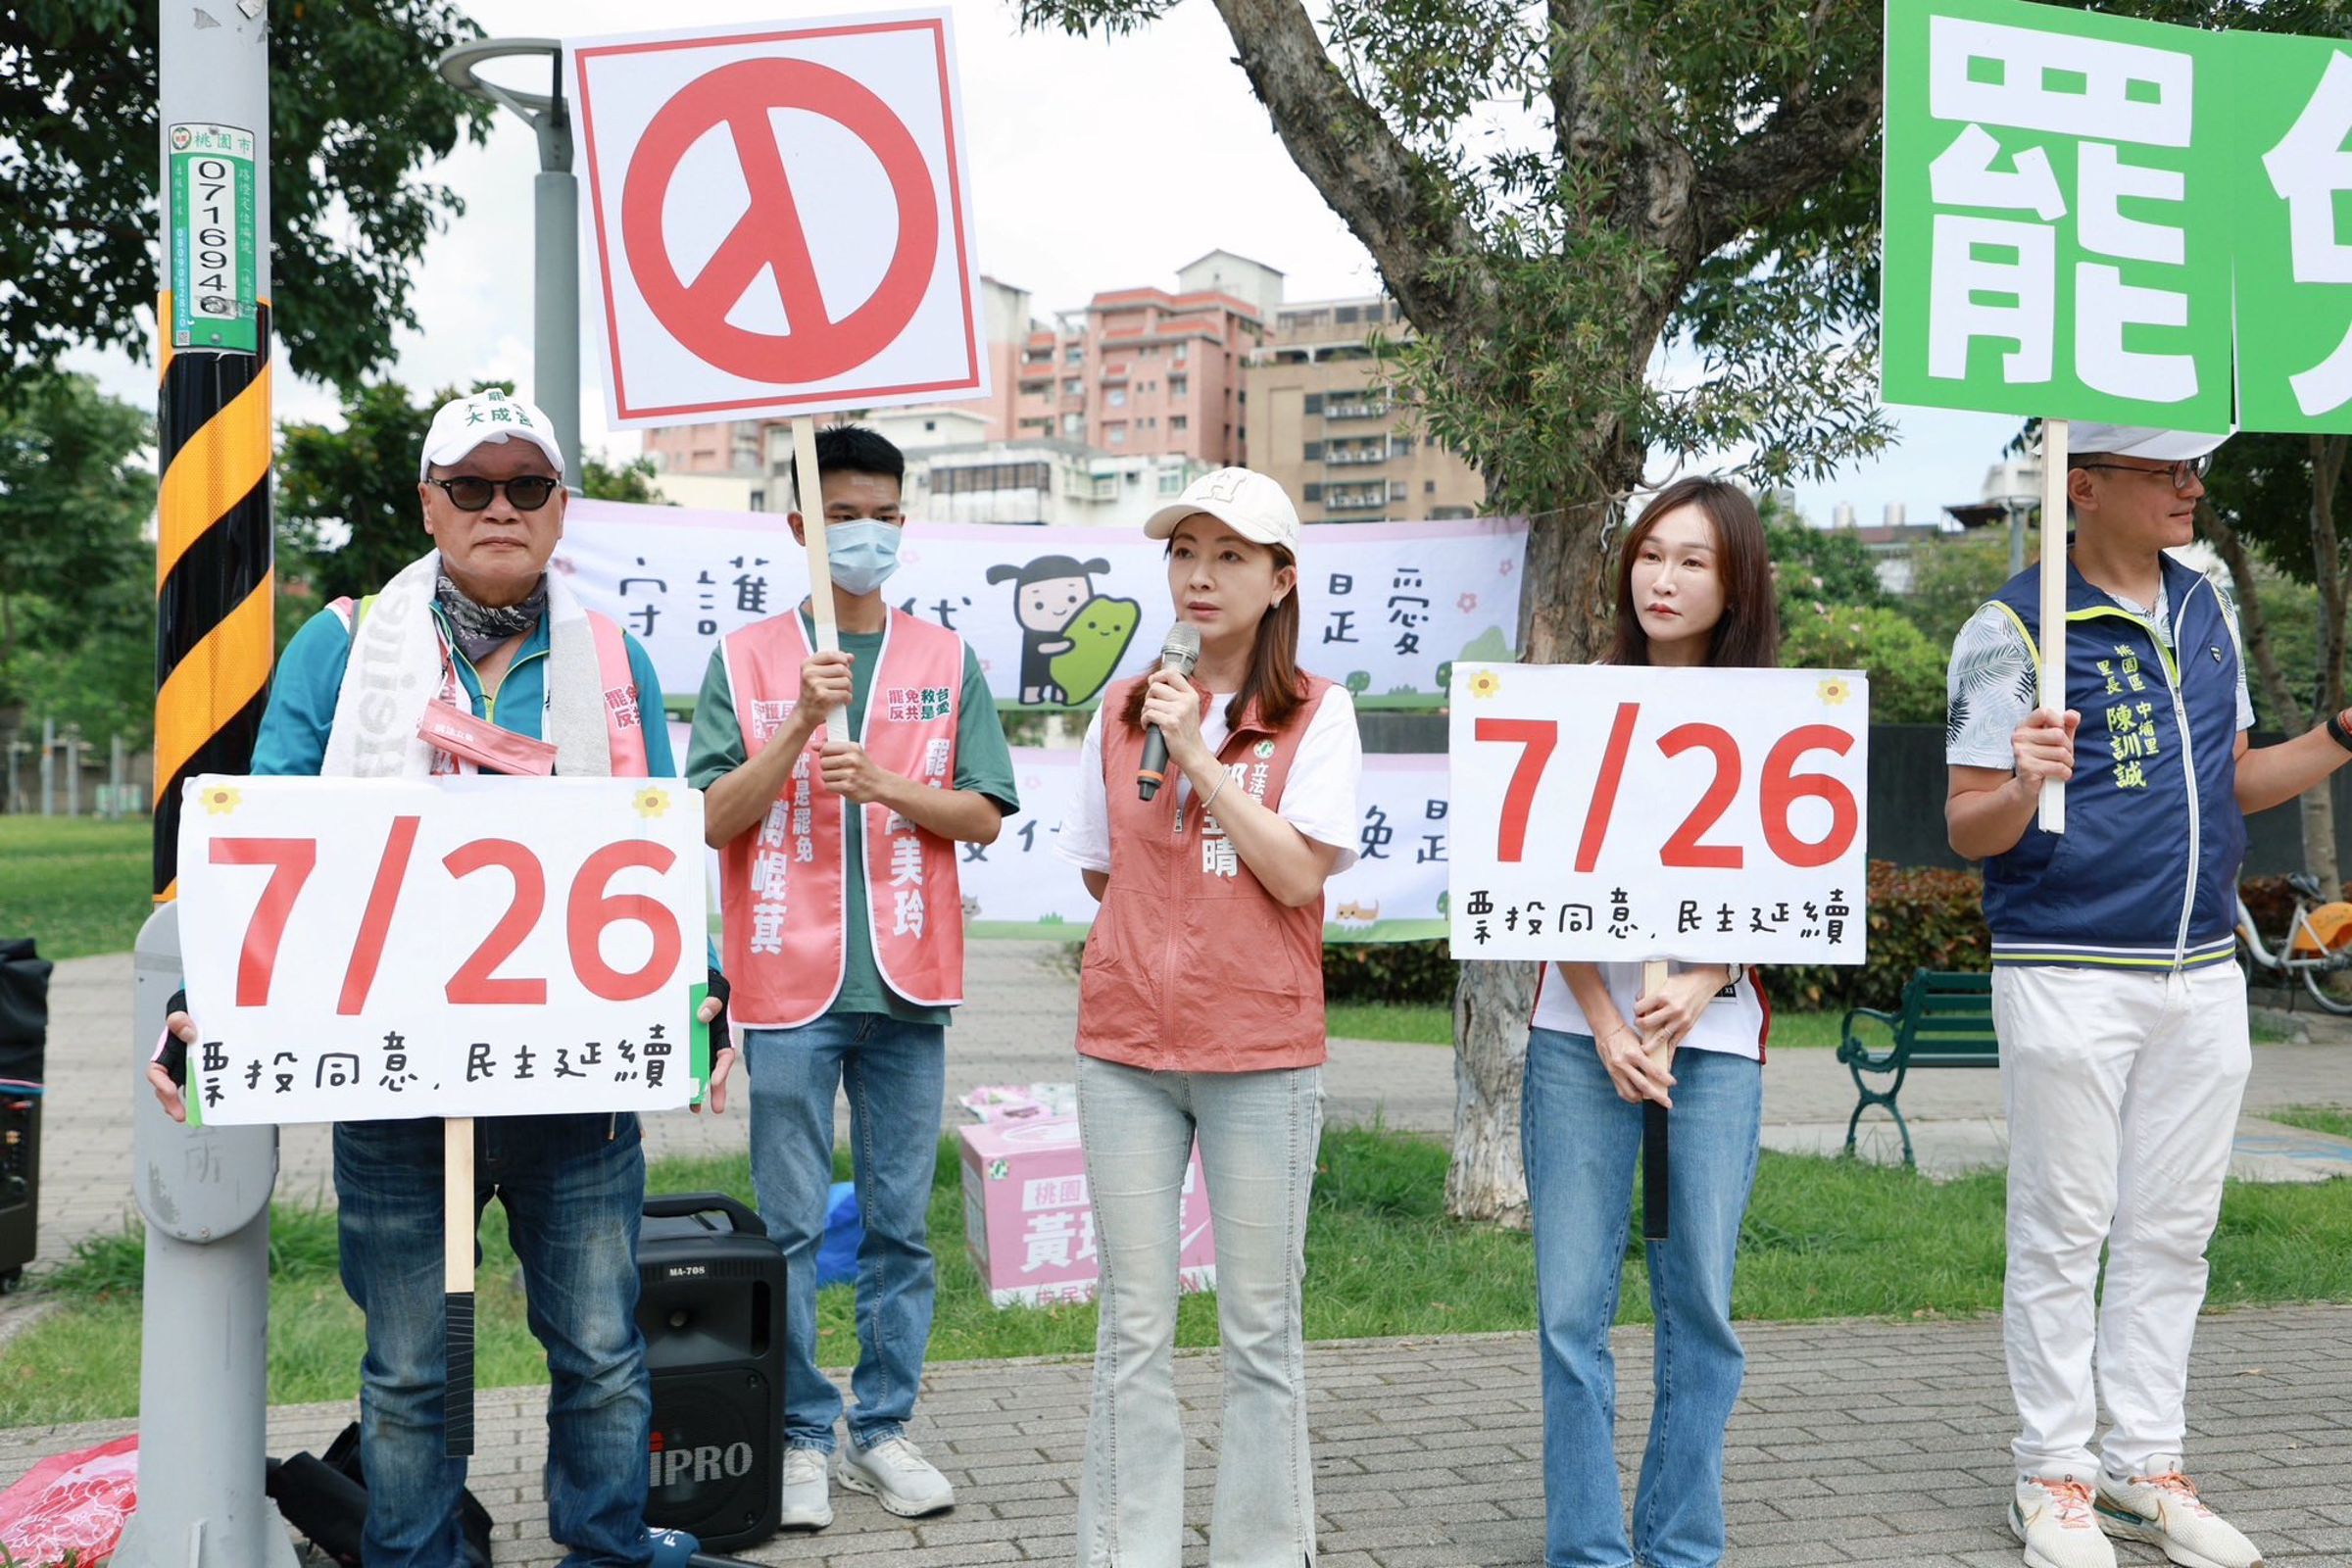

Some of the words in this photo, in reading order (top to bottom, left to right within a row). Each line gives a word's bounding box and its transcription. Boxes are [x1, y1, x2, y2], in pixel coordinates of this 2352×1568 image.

[195, 131, 252, 153] 桃園市
[618, 555, 769, 637] 守護
[1322, 566, 1431, 656] 是愛
[1474, 701, 1859, 873] 7/26
[2105, 704, 2147, 788] 陳訓誠
[209, 815, 682, 1015] 7/26
